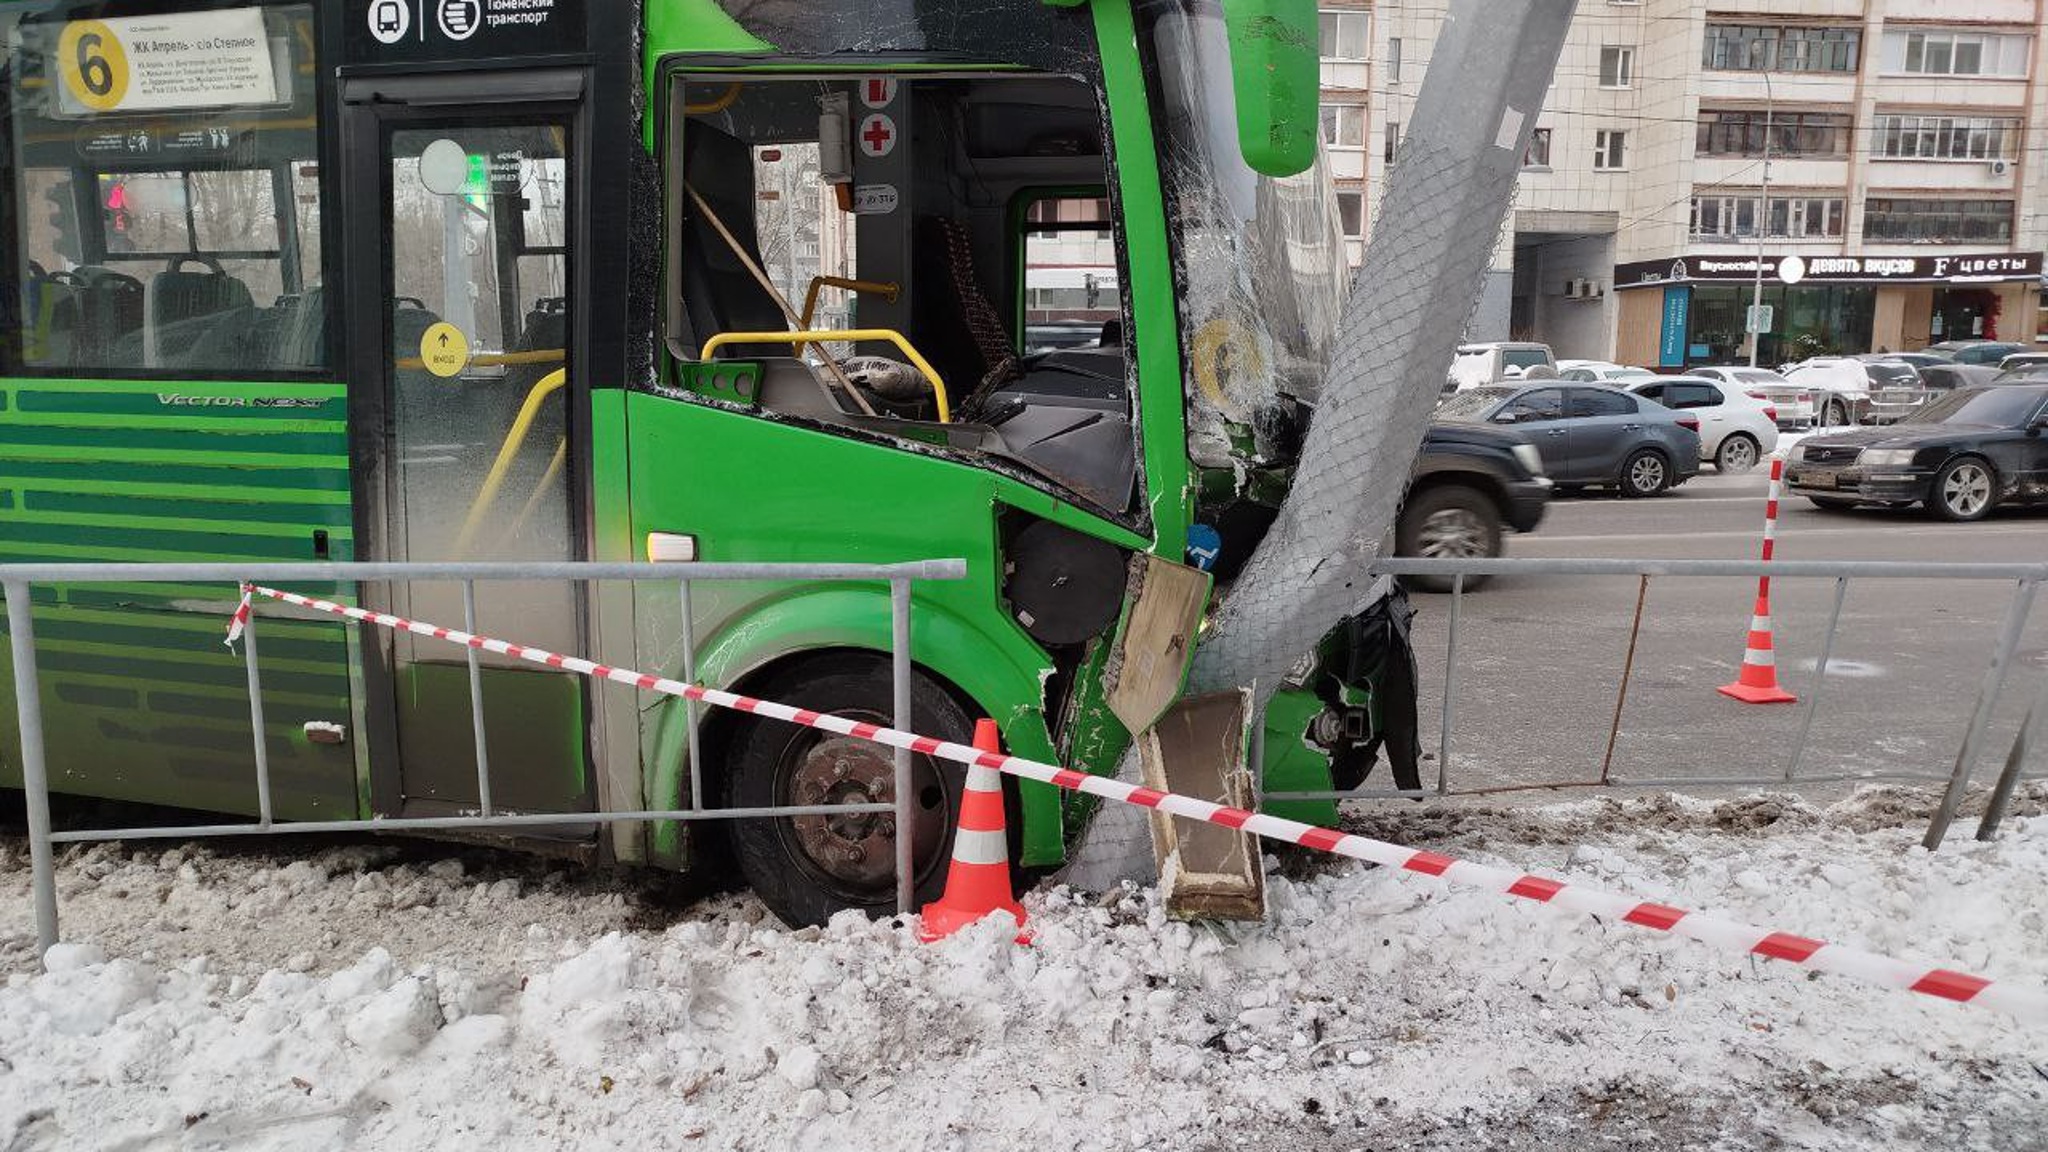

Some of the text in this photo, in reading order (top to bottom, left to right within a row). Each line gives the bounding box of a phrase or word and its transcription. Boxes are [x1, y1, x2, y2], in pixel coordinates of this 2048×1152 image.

[486, 12, 548, 27] транспорт
[132, 40, 150, 54] ЖК
[152, 40, 189, 55] Апрель
[213, 37, 256, 49] Степное
[77, 33, 113, 96] 6
[156, 393, 245, 407] VECTOR
